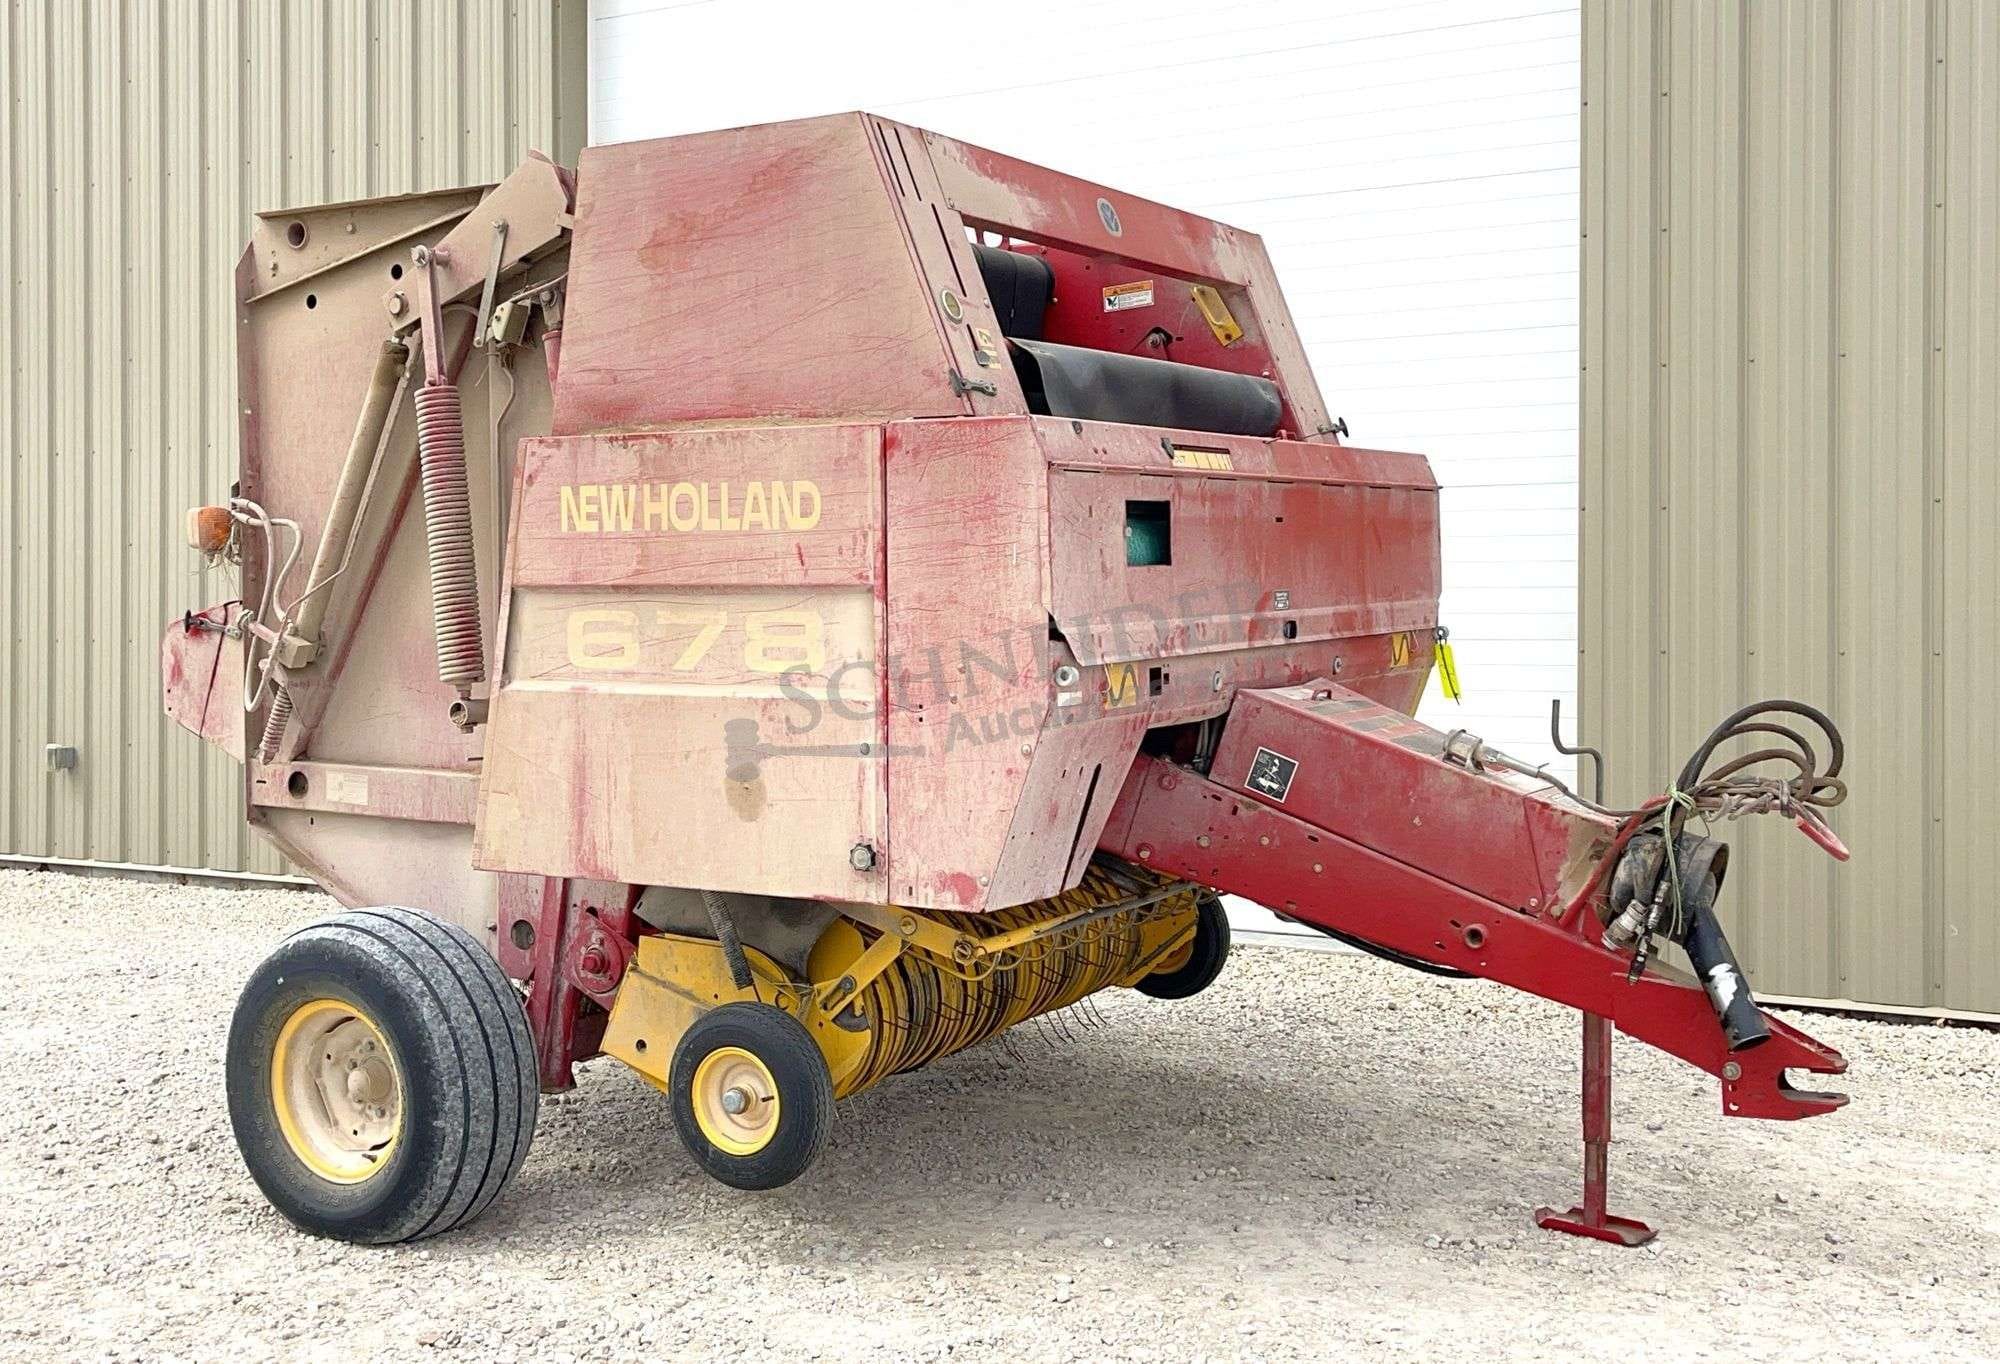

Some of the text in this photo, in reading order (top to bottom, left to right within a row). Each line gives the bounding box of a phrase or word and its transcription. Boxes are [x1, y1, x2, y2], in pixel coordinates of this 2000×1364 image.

[560, 480, 822, 532] NEW HOLLAND
[567, 609, 826, 673] 678
